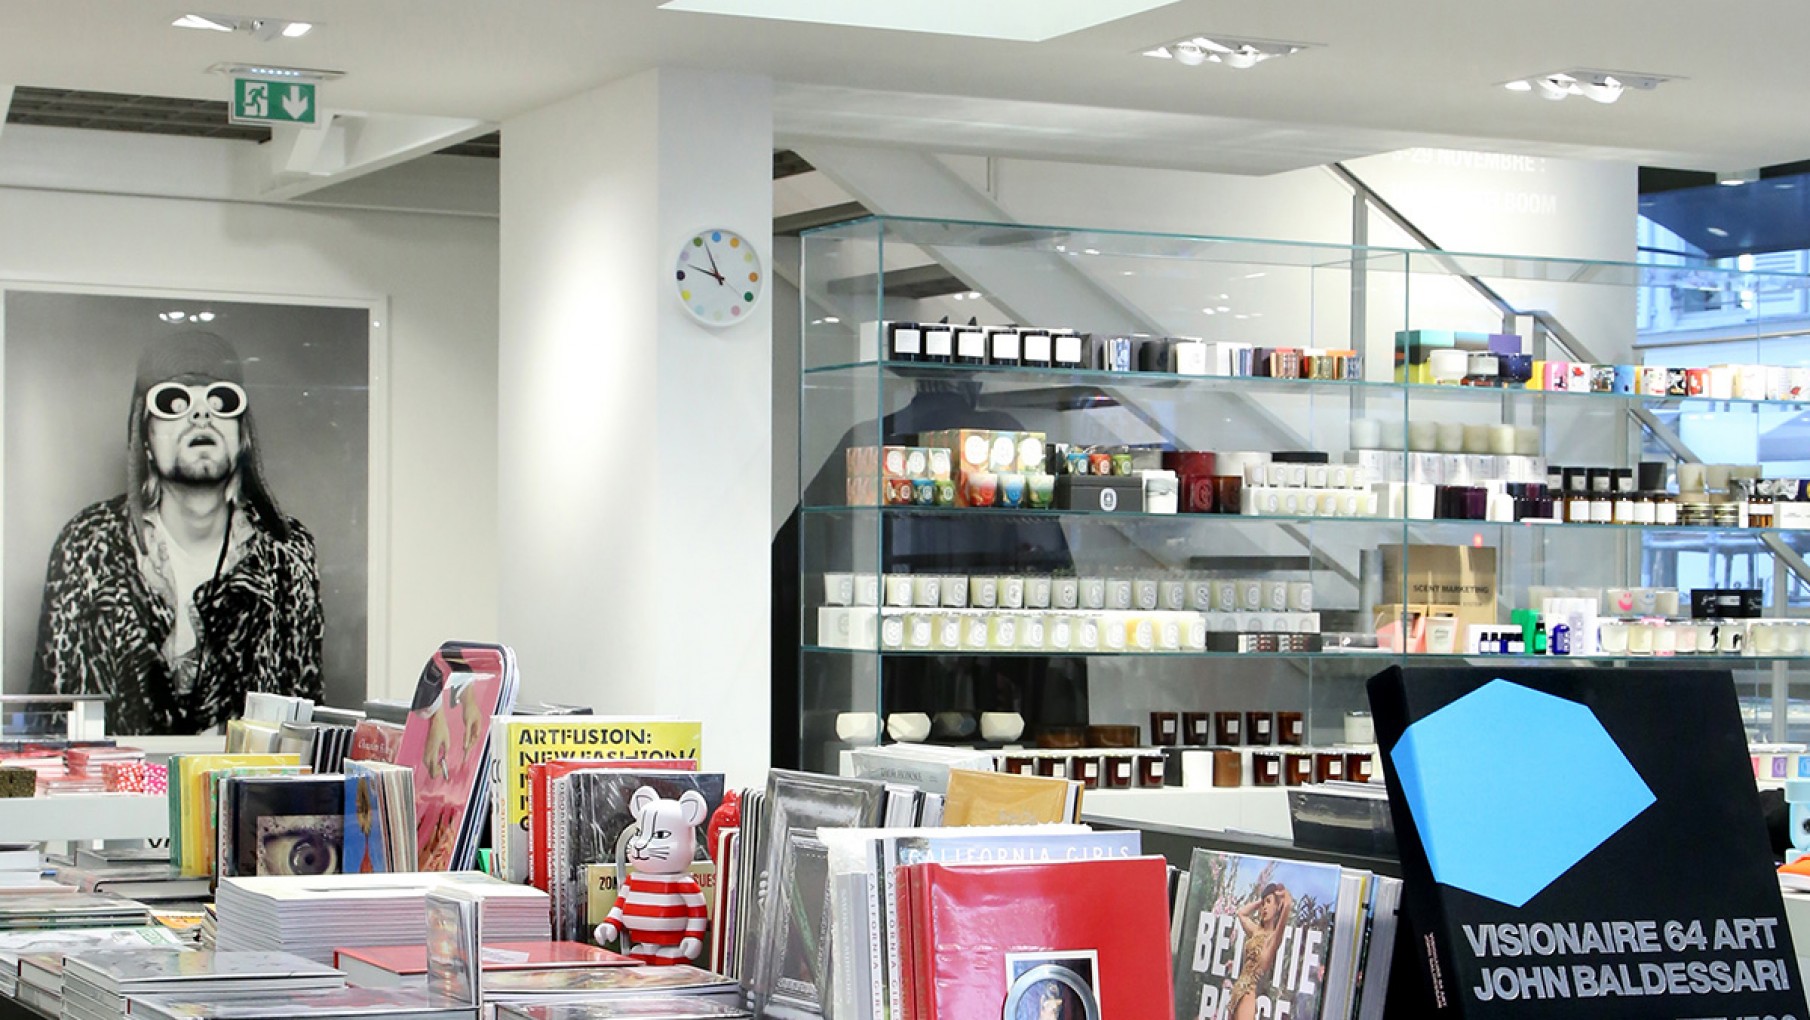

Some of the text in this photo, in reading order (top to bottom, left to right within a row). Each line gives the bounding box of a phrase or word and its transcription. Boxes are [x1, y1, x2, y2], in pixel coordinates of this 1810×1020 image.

[1413, 584, 1490, 594] SCENT MARKETING
[518, 728, 652, 746] ARTFUSION:
[869, 872, 879, 970] CALIFORNIA
[887, 871, 897, 969] CALIFORNIA
[1462, 917, 1778, 958] VISIONAIRE 64 ART
[1473, 965, 1570, 1002] JOHN
[1572, 958, 1790, 998] BALDESSARI
